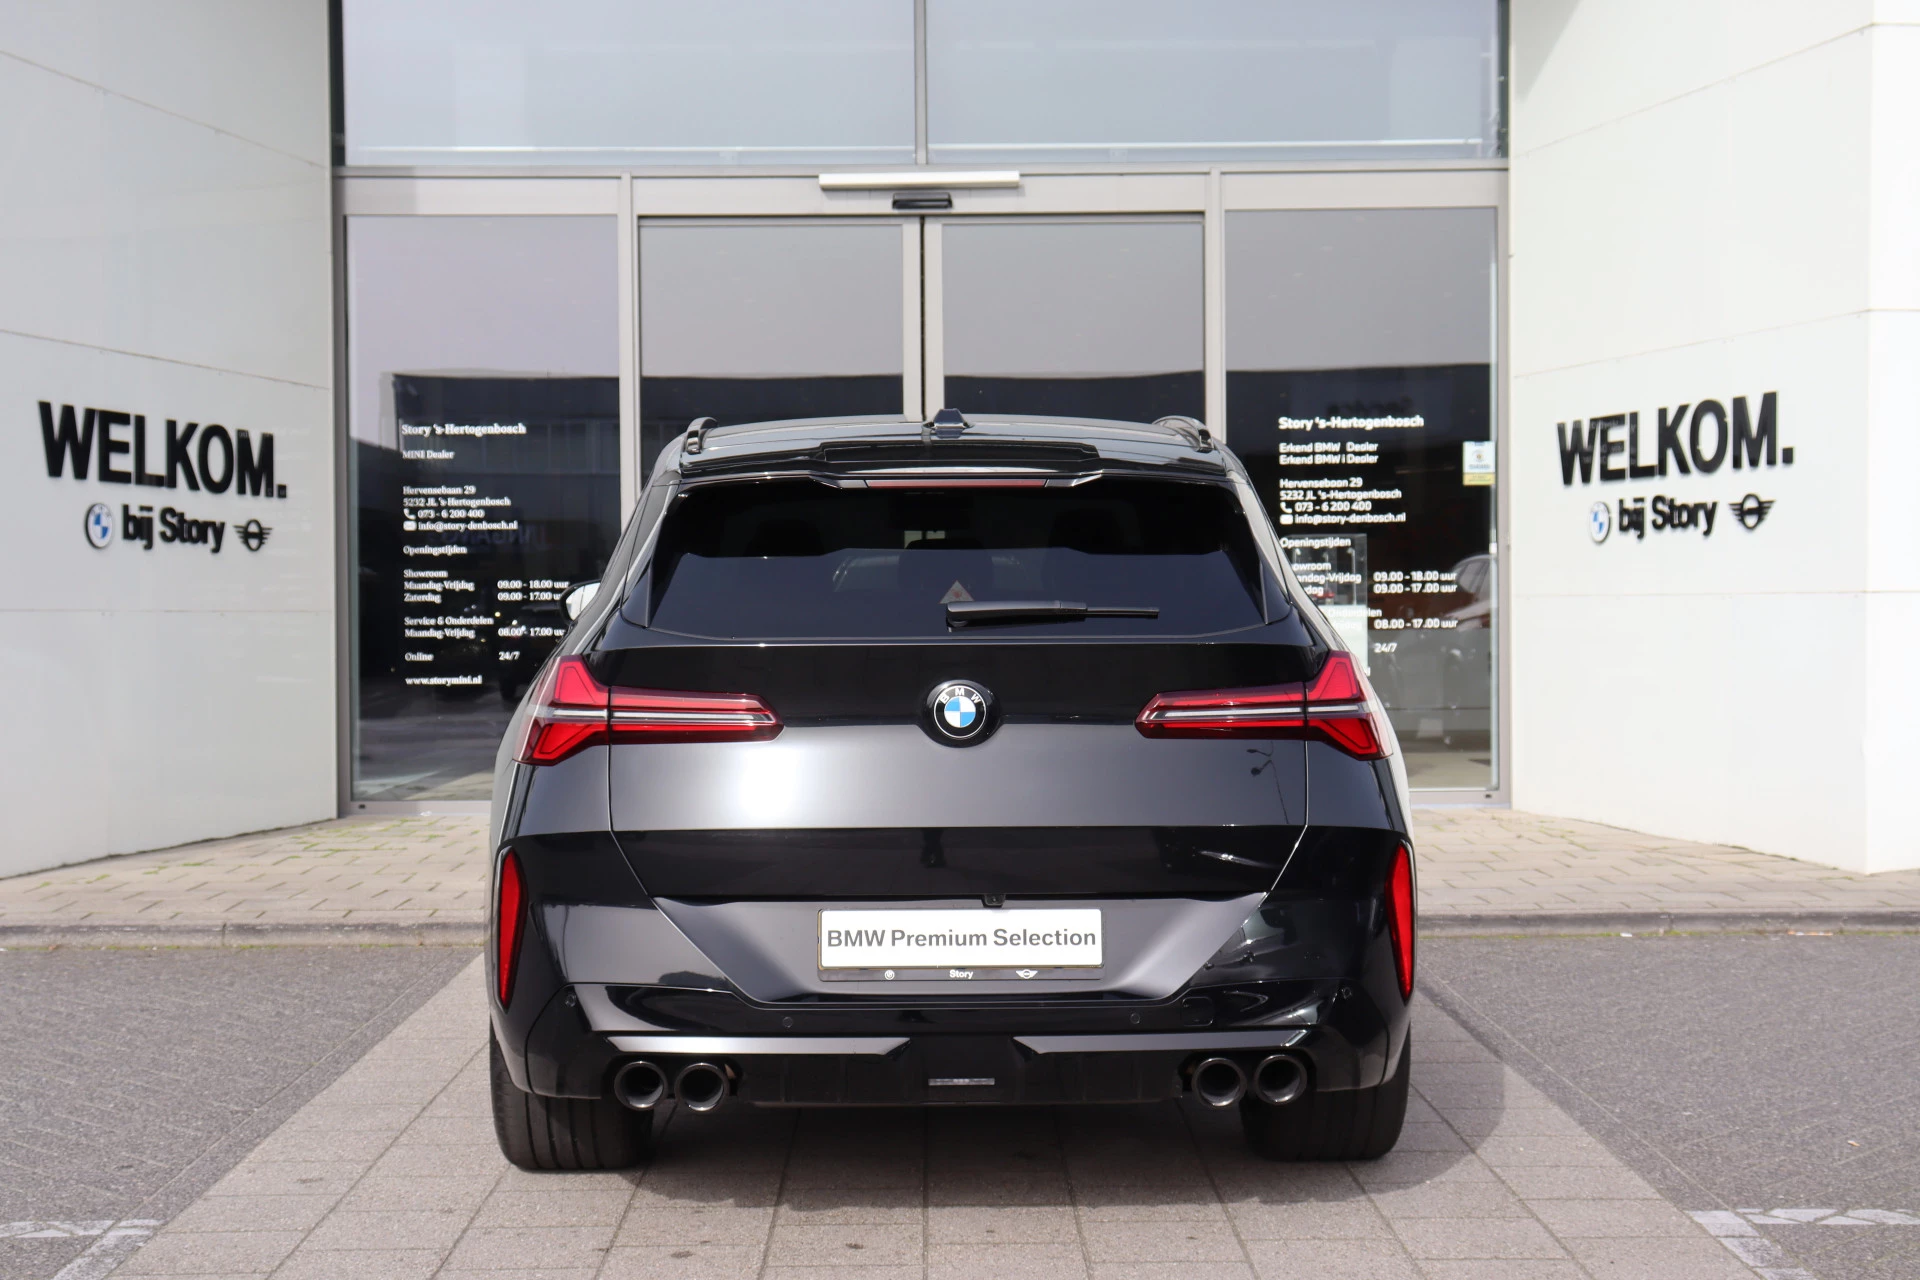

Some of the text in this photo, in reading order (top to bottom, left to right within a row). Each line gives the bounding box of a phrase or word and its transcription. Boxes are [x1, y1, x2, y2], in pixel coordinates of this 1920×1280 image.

[1278, 416, 1313, 431] Story
[401, 424, 431, 437] Story
[1557, 391, 1794, 487] WELKOM.
[38, 401, 287, 499] WELKOM.
[1279, 441, 1379, 453] Erkend BMW Dealer
[402, 450, 455, 459] MINI Dealer
[1279, 454, 1313, 465] Erkend
[1314, 453, 1341, 465] BMW
[1346, 453, 1379, 465] Dealer
[1279, 477, 1364, 488] Hervensebaan 29
[403, 485, 476, 496] Hervensebaan 29
[1279, 490, 1304, 501] 5232
[1305, 490, 1317, 501] JL
[403, 498, 425, 508] 5232
[425, 497, 438, 507] JL
[1294, 501, 1314, 512] 073
[1321, 501, 1330, 512] 6
[1330, 501, 1351, 512] 200
[1351, 501, 1373, 511] 400
[418, 509, 435, 519] 073
[441, 509, 448, 518] 6
[448, 509, 467, 518] 200
[467, 509, 485, 518] 400
[1294, 512, 1407, 525] info@story-denbosch.nl
[1618, 495, 1718, 540] bij Story
[122, 504, 226, 554] bij Story
[418, 520, 519, 532] info@story-denbosch.nl
[1279, 537, 1352, 549] Openingstijden
[403, 545, 468, 556] Openingstijden
[1291, 563, 1332, 571] owroom
[403, 569, 449, 578] Showroom
[1373, 571, 1404, 582] 09.00
[1411, 571, 1440, 582] 18.00
[1440, 572, 1457, 581] uur
[404, 580, 475, 592] Maandag-Vrijdag
[497, 580, 522, 590] 09.00
[529, 580, 553, 589] 18.00
[554, 581, 570, 589] uur
[1373, 583, 1404, 594] 09.00
[1411, 583, 1440, 593] 17.00
[1440, 584, 1458, 593] uur
[403, 593, 442, 604] Zaterdag
[497, 592, 522, 601] 09.00
[529, 592, 553, 601] 17.00
[404, 617, 437, 626] Service
[445, 616, 495, 626] Onderdelen
[1373, 618, 1405, 629] 08.00
[1412, 618, 1440, 628] 17.00
[1440, 619, 1459, 628] uur
[404, 627, 476, 639] Maandag-Vrijdag
[497, 627, 523, 637] 08.00
[530, 627, 553, 637] 17.00
[1374, 642, 1397, 653] 24/7
[404, 651, 520, 661] Online 24/7
[405, 675, 483, 686] www.storymini.nl
[939, 687, 983, 705] BMW
[827, 928, 1096, 947] BMW Premium Selection
[949, 969, 974, 979] Story
